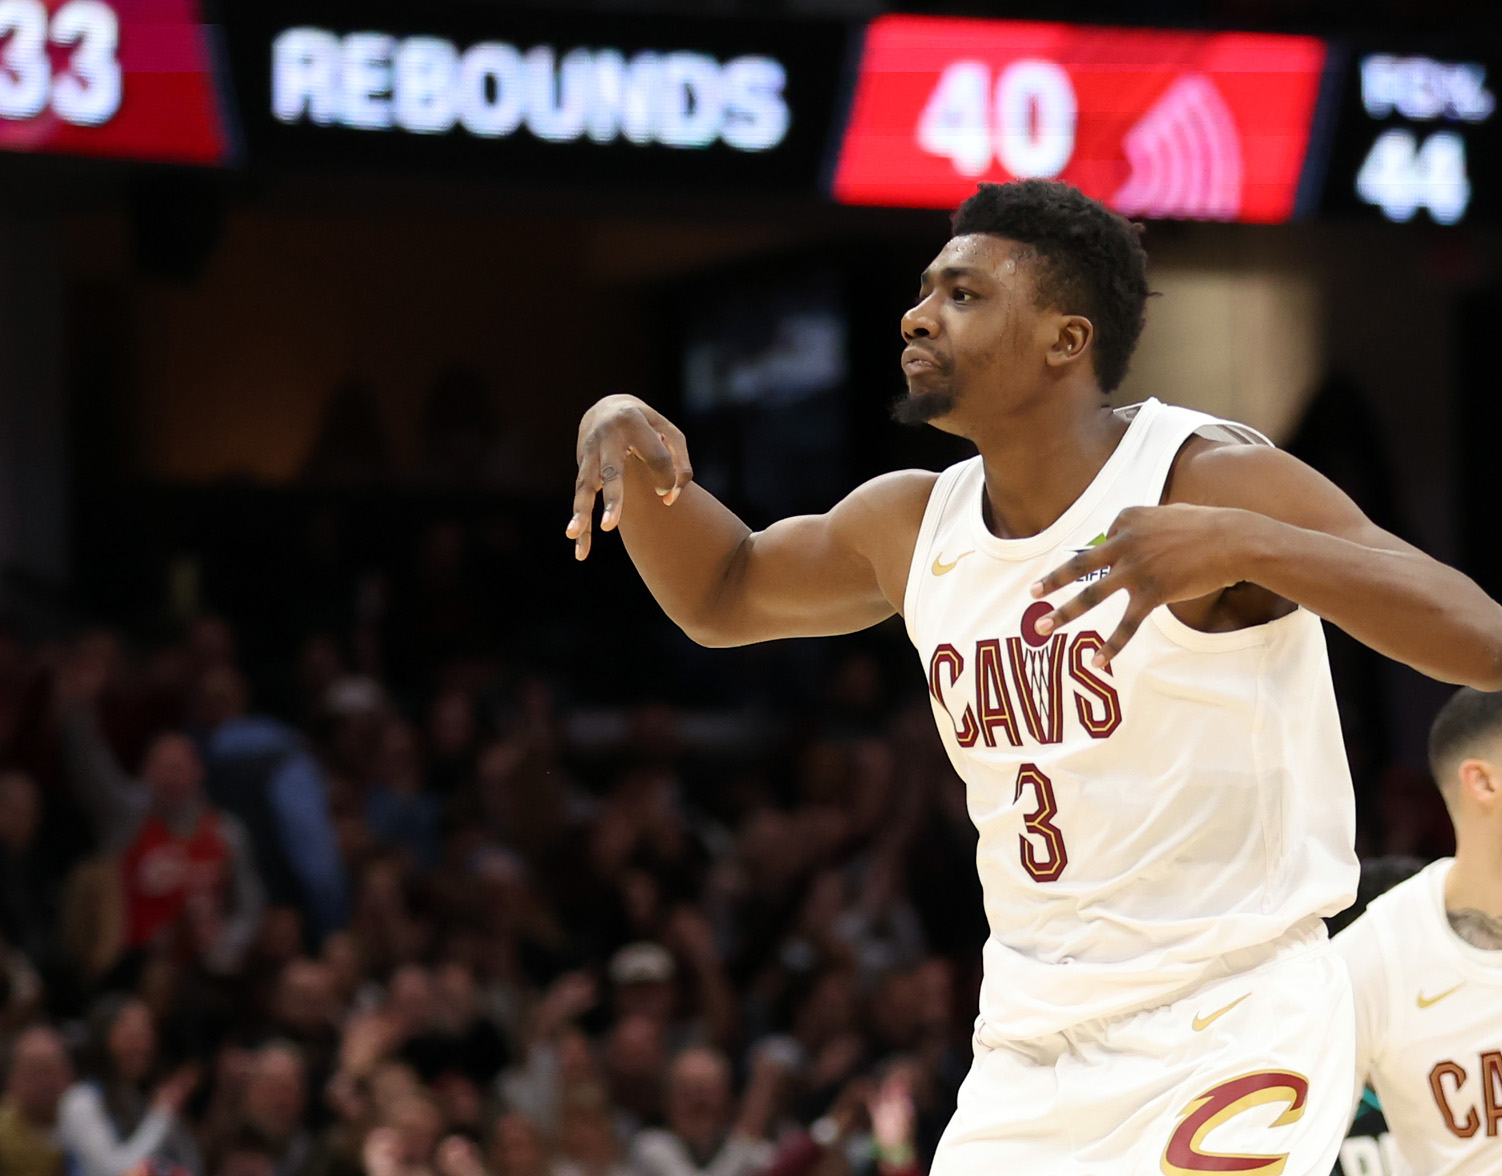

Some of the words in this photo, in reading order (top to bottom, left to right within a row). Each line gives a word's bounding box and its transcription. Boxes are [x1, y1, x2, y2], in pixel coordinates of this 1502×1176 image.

[0, 0, 121, 126] 33
[272, 26, 790, 152] REBOUNDS
[916, 57, 1078, 183] 40
[1355, 129, 1470, 224] 44
[929, 629, 1123, 749] CAVS
[1012, 762, 1068, 883] 3
